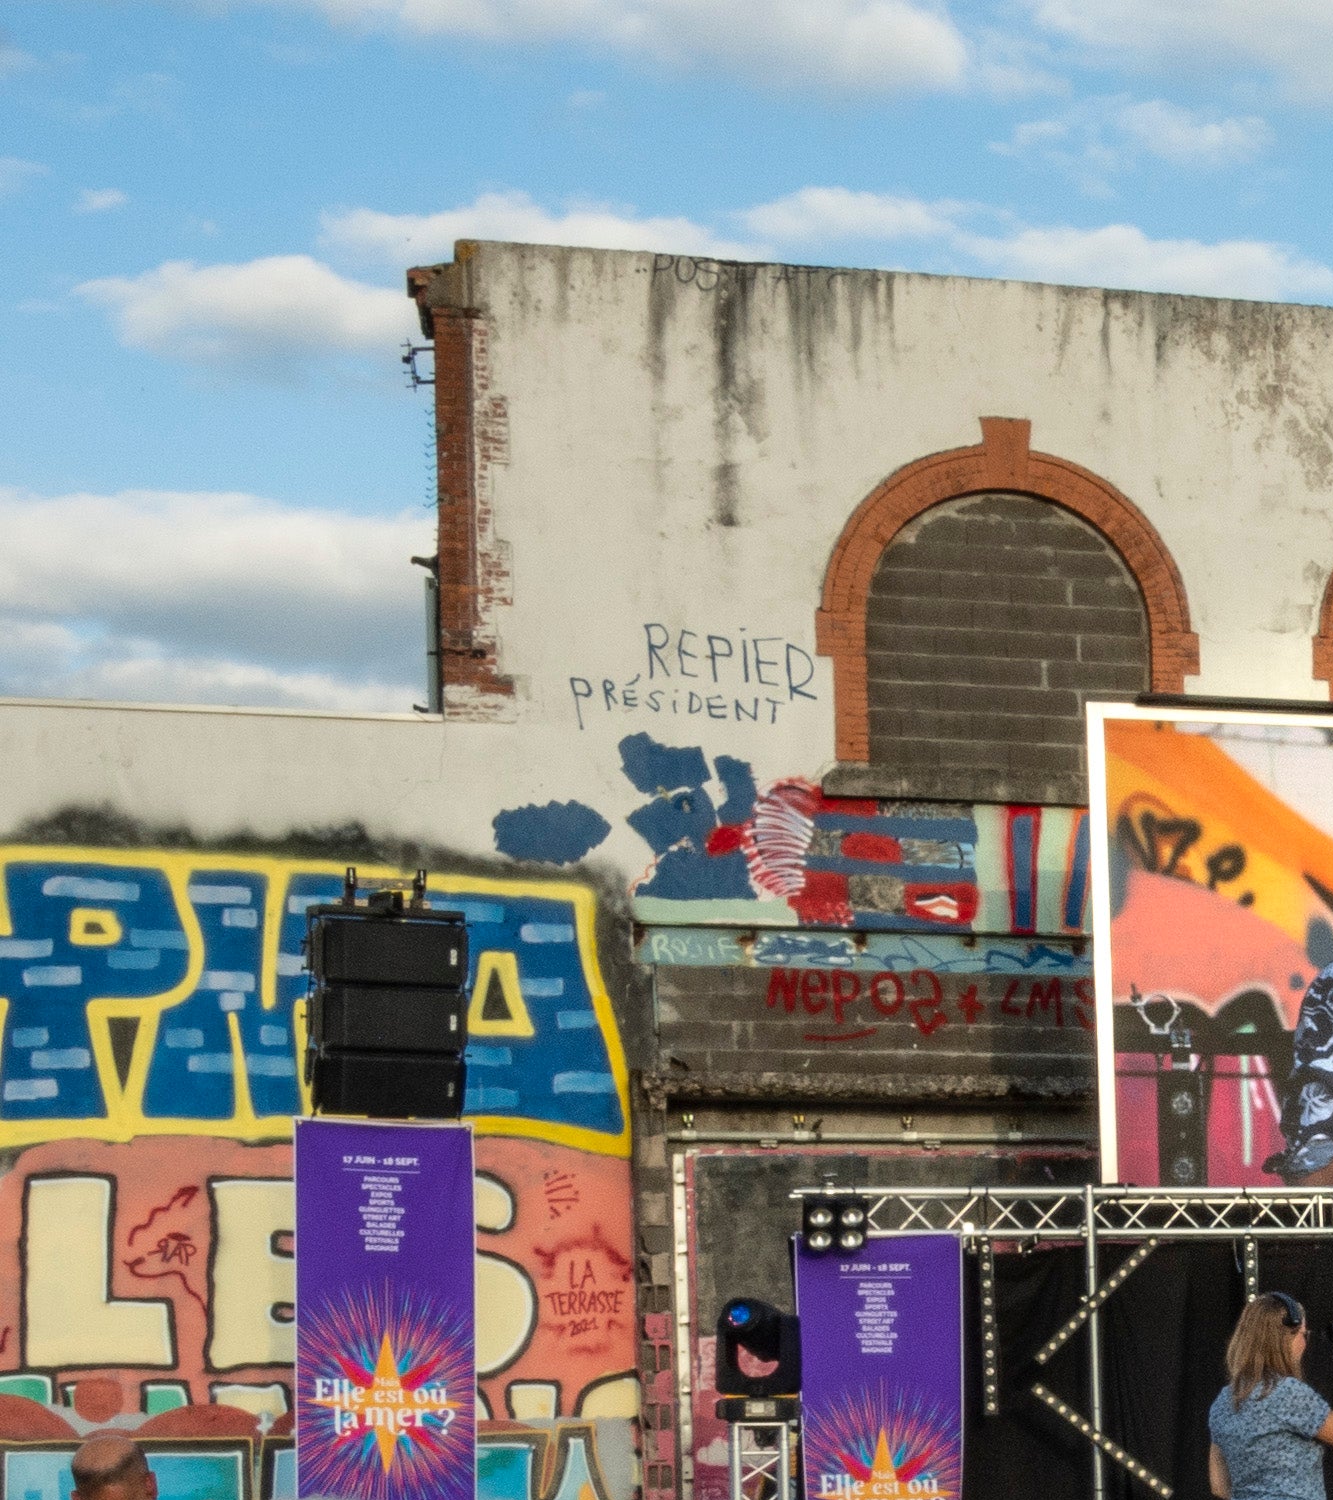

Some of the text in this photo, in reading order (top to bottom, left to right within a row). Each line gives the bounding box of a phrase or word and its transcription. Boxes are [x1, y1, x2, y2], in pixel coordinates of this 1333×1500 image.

[570, 1260, 597, 1289] LA
[545, 1290, 624, 1316] TERRASSE
[315, 1378, 366, 1410] Elle
[374, 1387, 404, 1403] est
[365, 1406, 430, 1435] mer
[438, 1408, 455, 1435] ?
[872, 1481, 900, 1495] est
